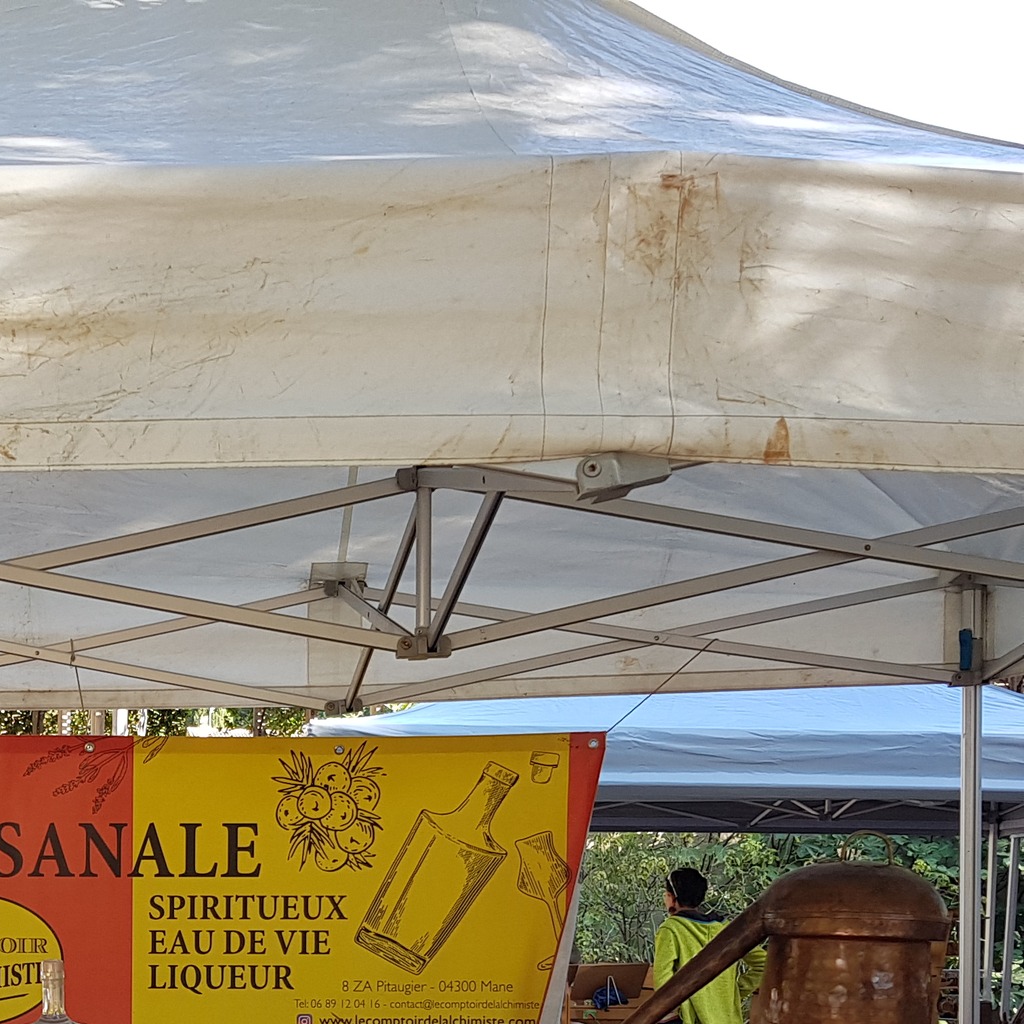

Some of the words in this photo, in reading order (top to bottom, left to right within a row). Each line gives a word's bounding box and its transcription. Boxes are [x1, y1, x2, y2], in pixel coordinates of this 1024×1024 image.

[148, 894, 348, 920] SPIRITUEUX
[148, 930, 213, 955] EAU
[224, 930, 267, 955] DE
[276, 930, 331, 955] VIE
[148, 964, 295, 995] LIQUEUR
[341, 981, 350, 992] 8
[353, 981, 373, 992] ZA
[376, 980, 427, 995] Pitaugier
[438, 981, 477, 993] 04300
[481, 981, 514, 993] Mane
[311, 999, 323, 1009] 06
[325, 999, 337, 1009] 89
[340, 999, 351, 1009] 12
[354, 1000, 366, 1009] 04
[370, 1000, 381, 1009] 16
